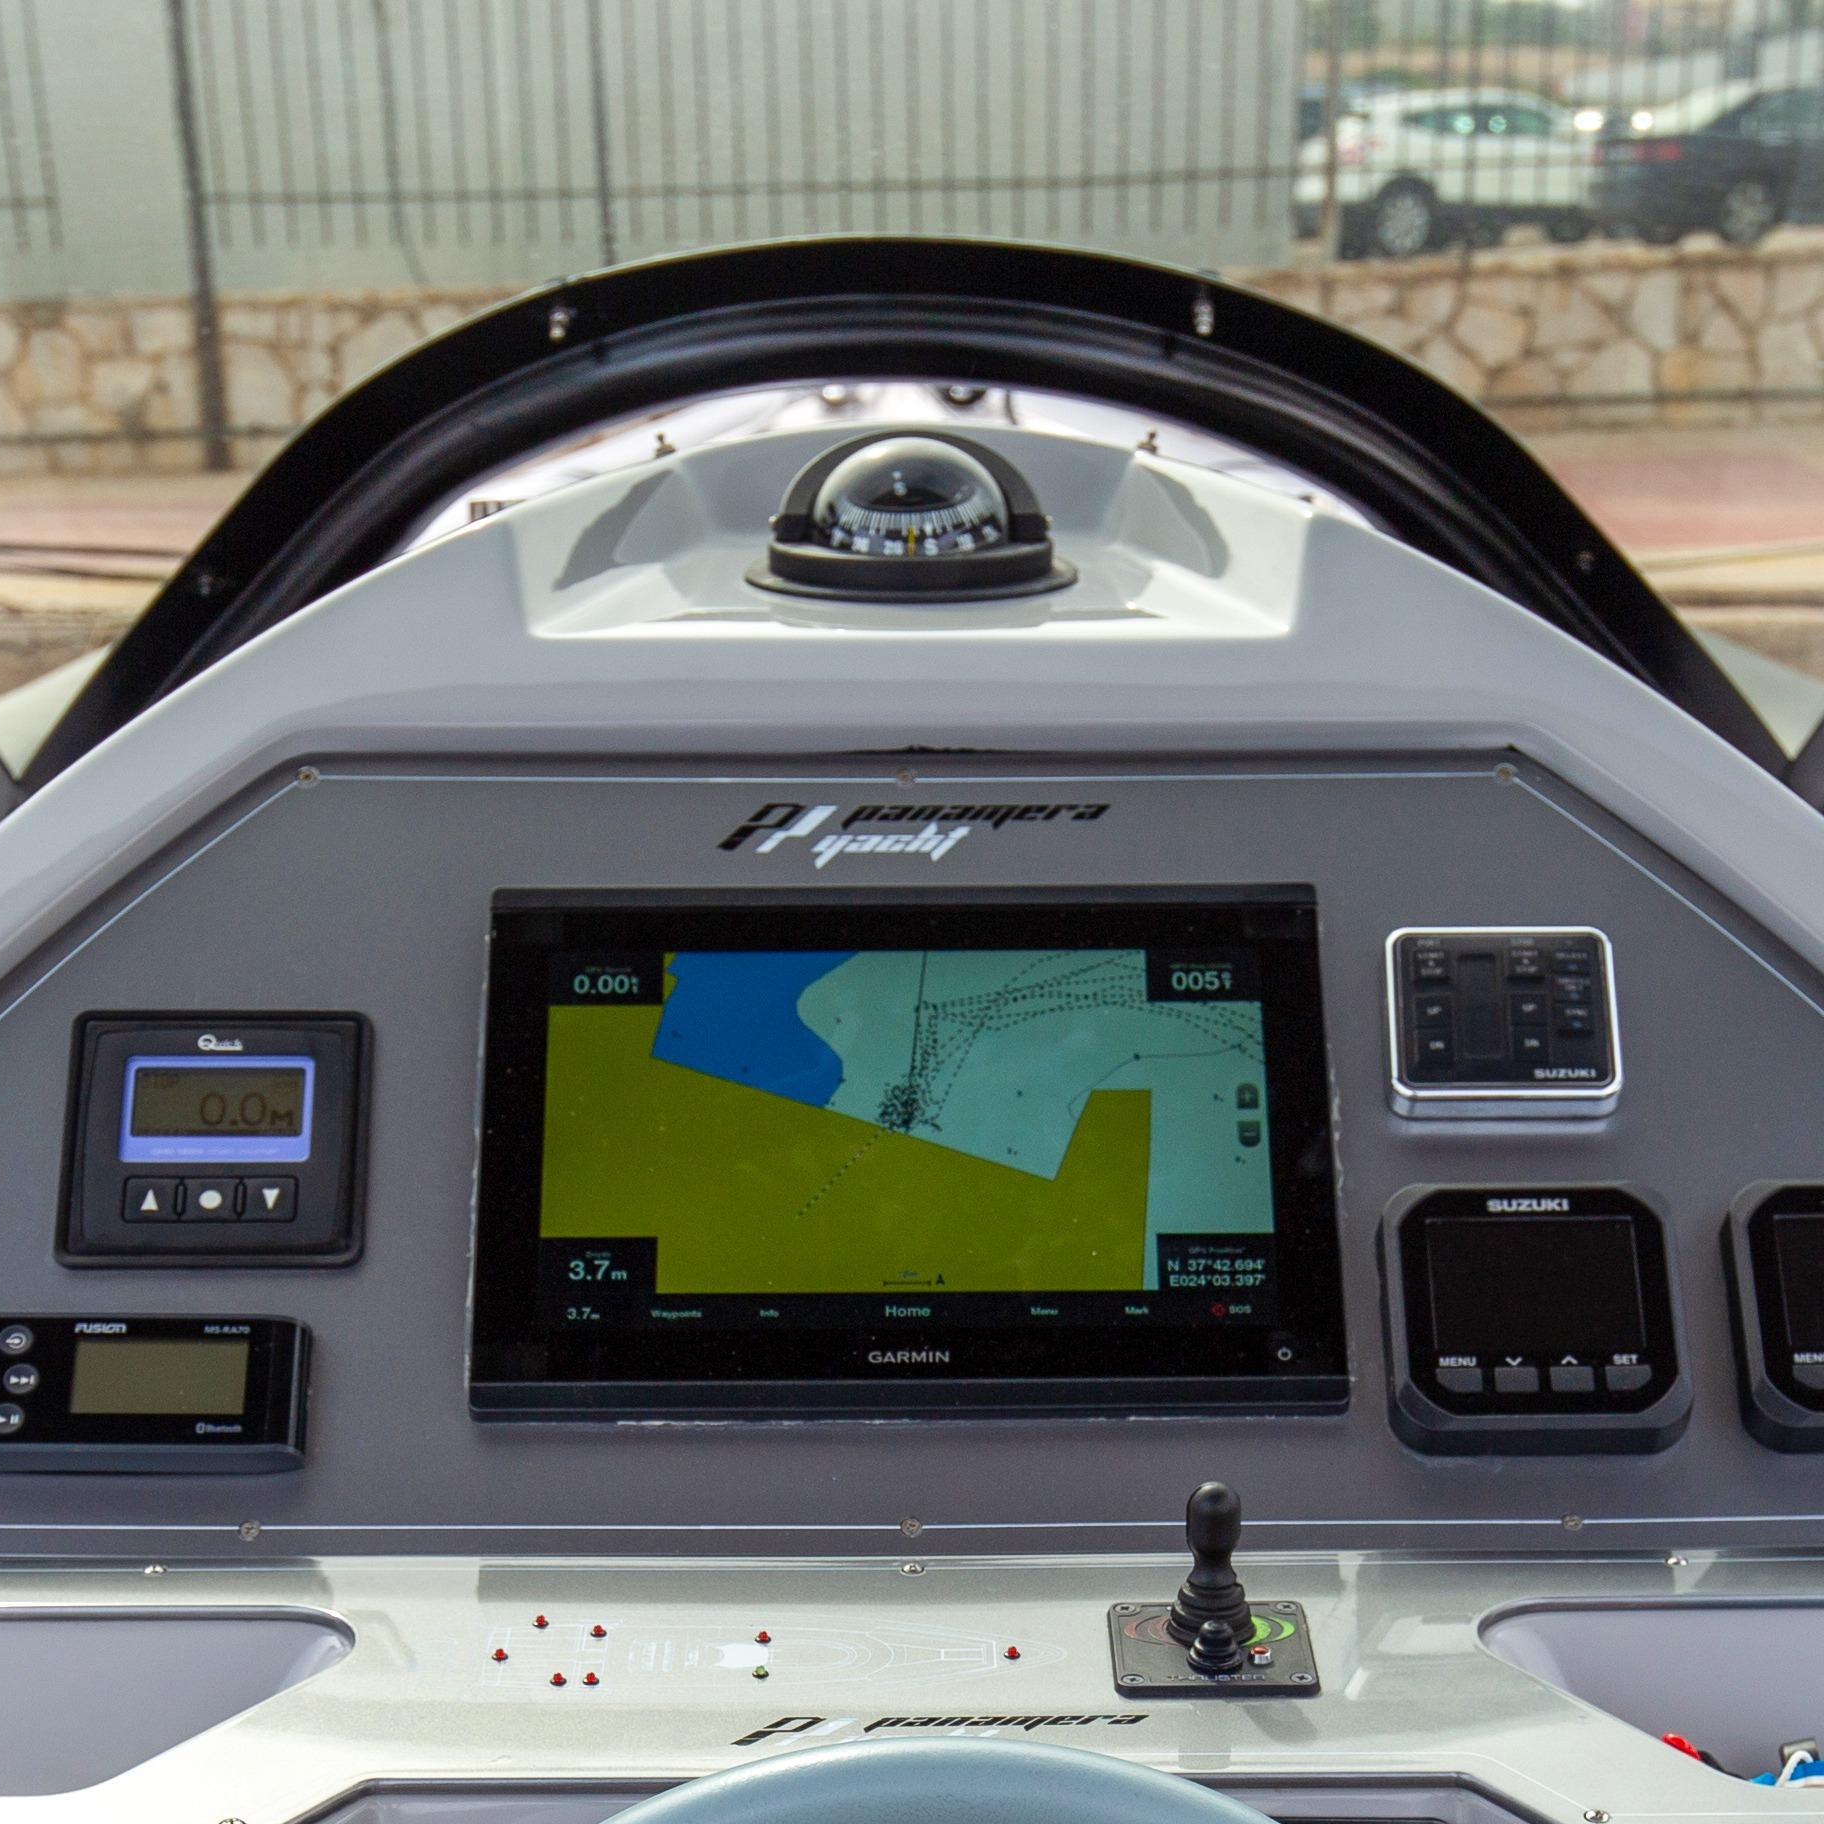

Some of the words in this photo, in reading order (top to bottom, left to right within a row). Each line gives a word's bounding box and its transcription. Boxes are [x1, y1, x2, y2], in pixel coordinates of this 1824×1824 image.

[841, 802, 1112, 830] panamera
[811, 821, 973, 870] yacht
[1533, 1068, 1597, 1079] SUZUKI
[1486, 1198, 1570, 1212] SUZUKI
[885, 1305, 931, 1317] Home
[868, 1351, 950, 1363] GARMIN
[1439, 1356, 1477, 1367] MENU
[1612, 1353, 1639, 1365] SET
